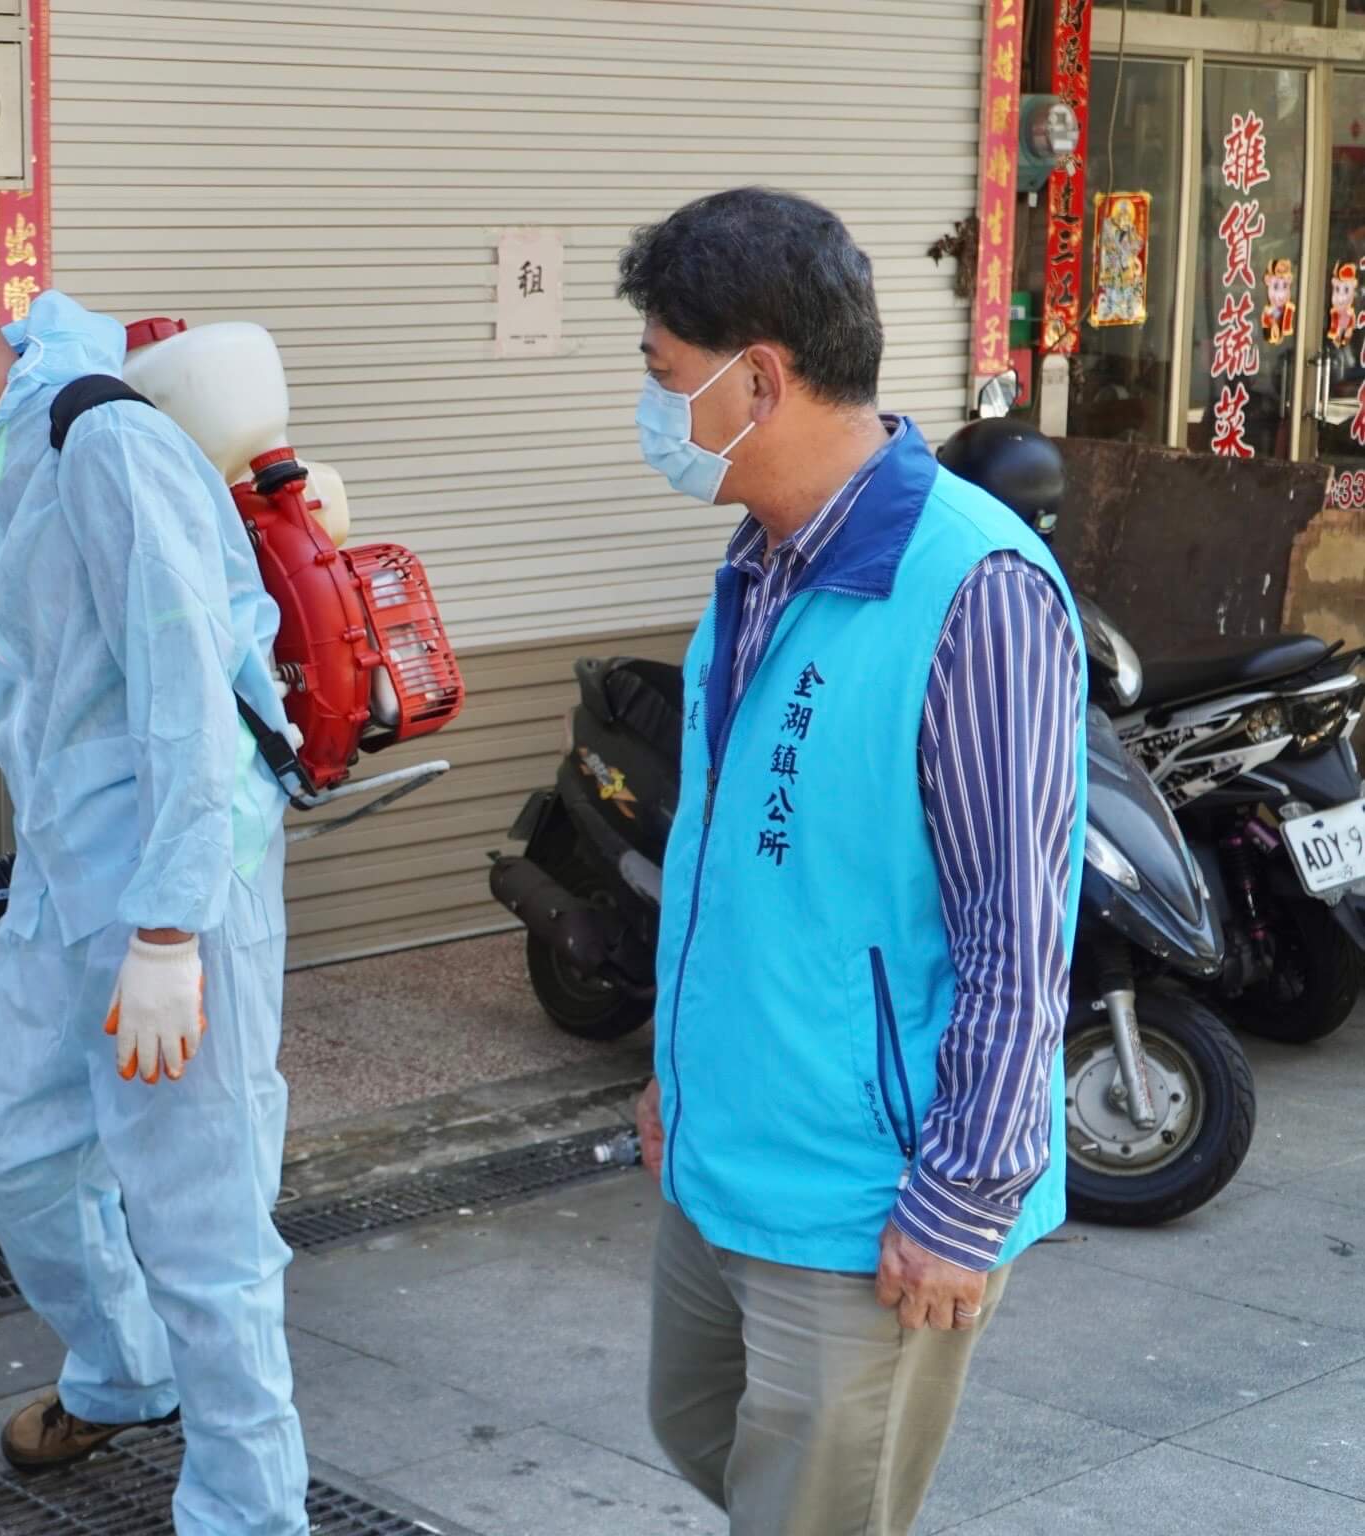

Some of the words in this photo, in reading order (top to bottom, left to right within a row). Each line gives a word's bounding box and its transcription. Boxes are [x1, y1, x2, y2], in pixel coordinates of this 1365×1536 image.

[517, 260, 544, 298] 租
[1050, 0, 1086, 306] 財源達三江
[1212, 111, 1270, 457] 雜貨蔬菜
[756, 661, 825, 867] 金湖鎮公所
